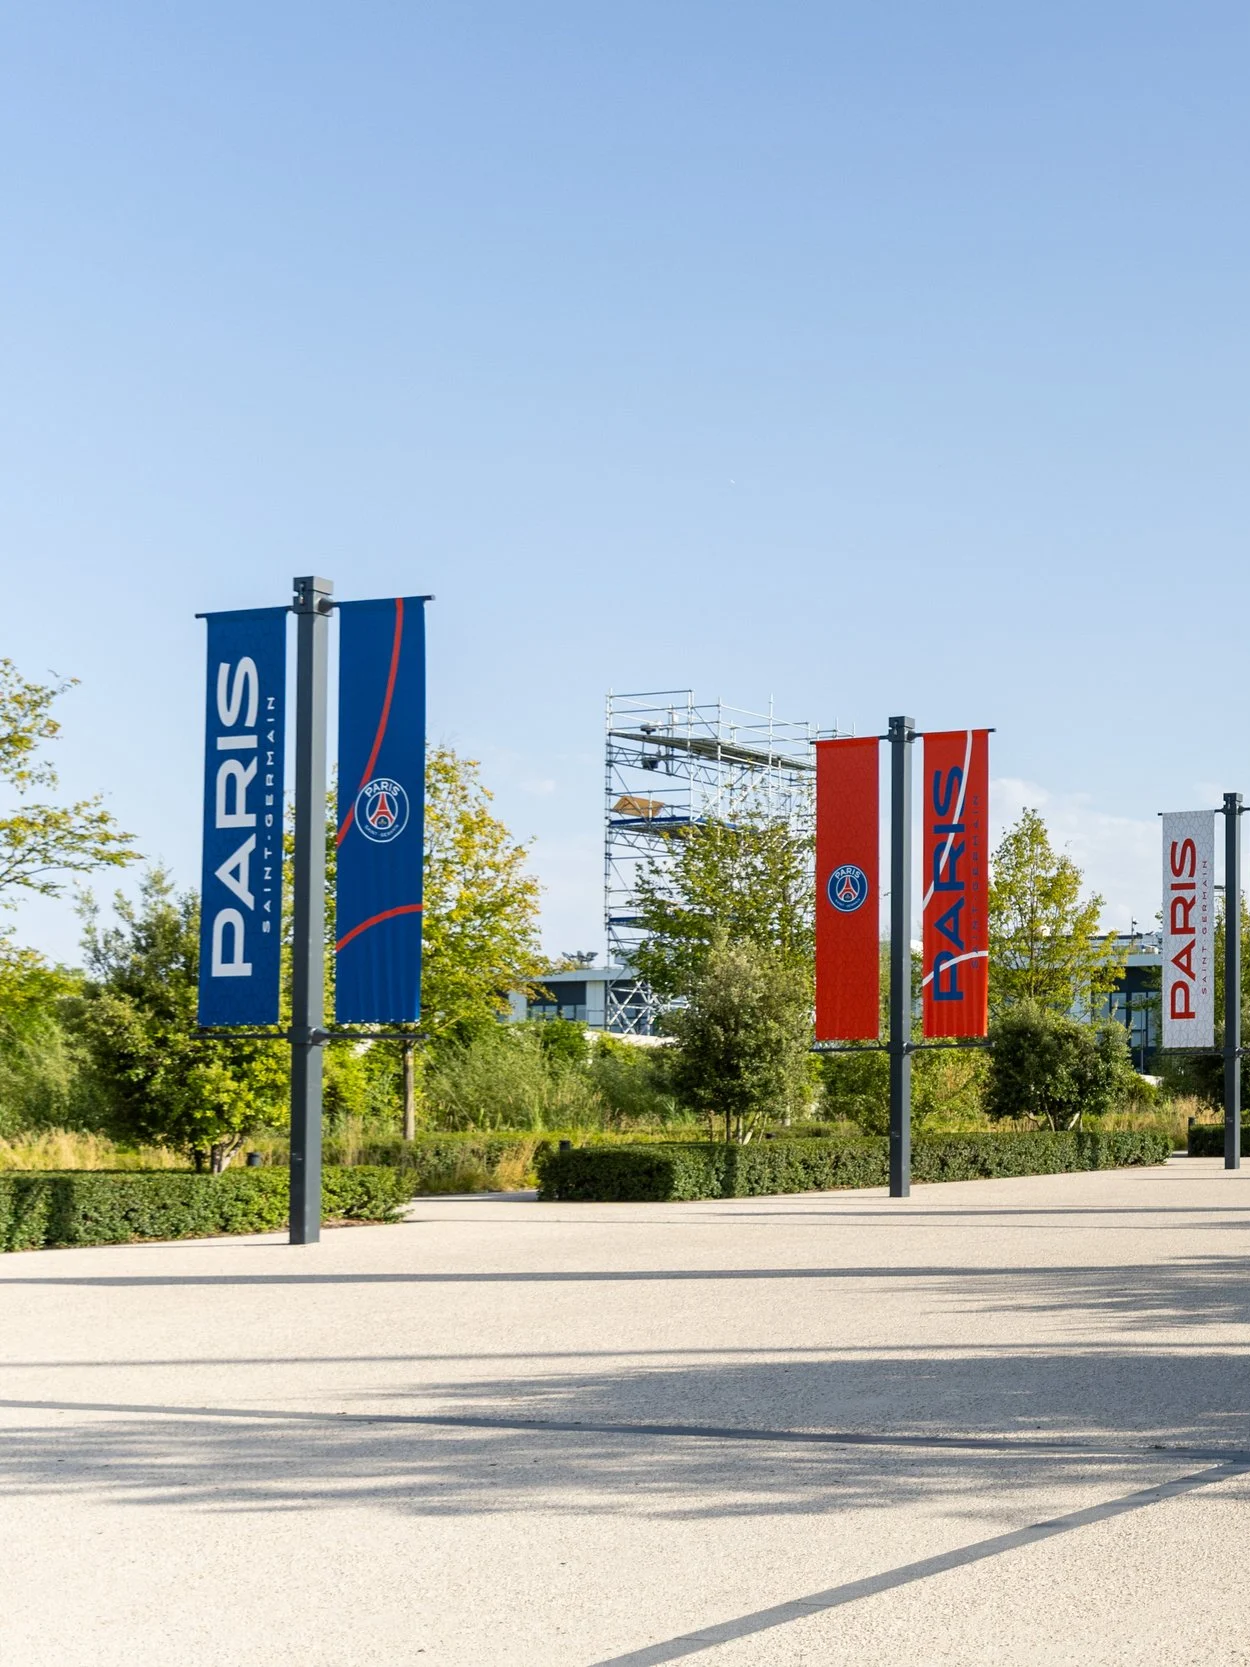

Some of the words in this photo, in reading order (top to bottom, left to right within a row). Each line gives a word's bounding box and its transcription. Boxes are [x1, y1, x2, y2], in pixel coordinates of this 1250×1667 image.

[211, 655, 260, 977] PARIS
[364, 781, 401, 798] PARIS
[834, 867, 861, 880] PARIS
[933, 765, 966, 1001] PARIS
[1170, 837, 1197, 1020] PARIS
